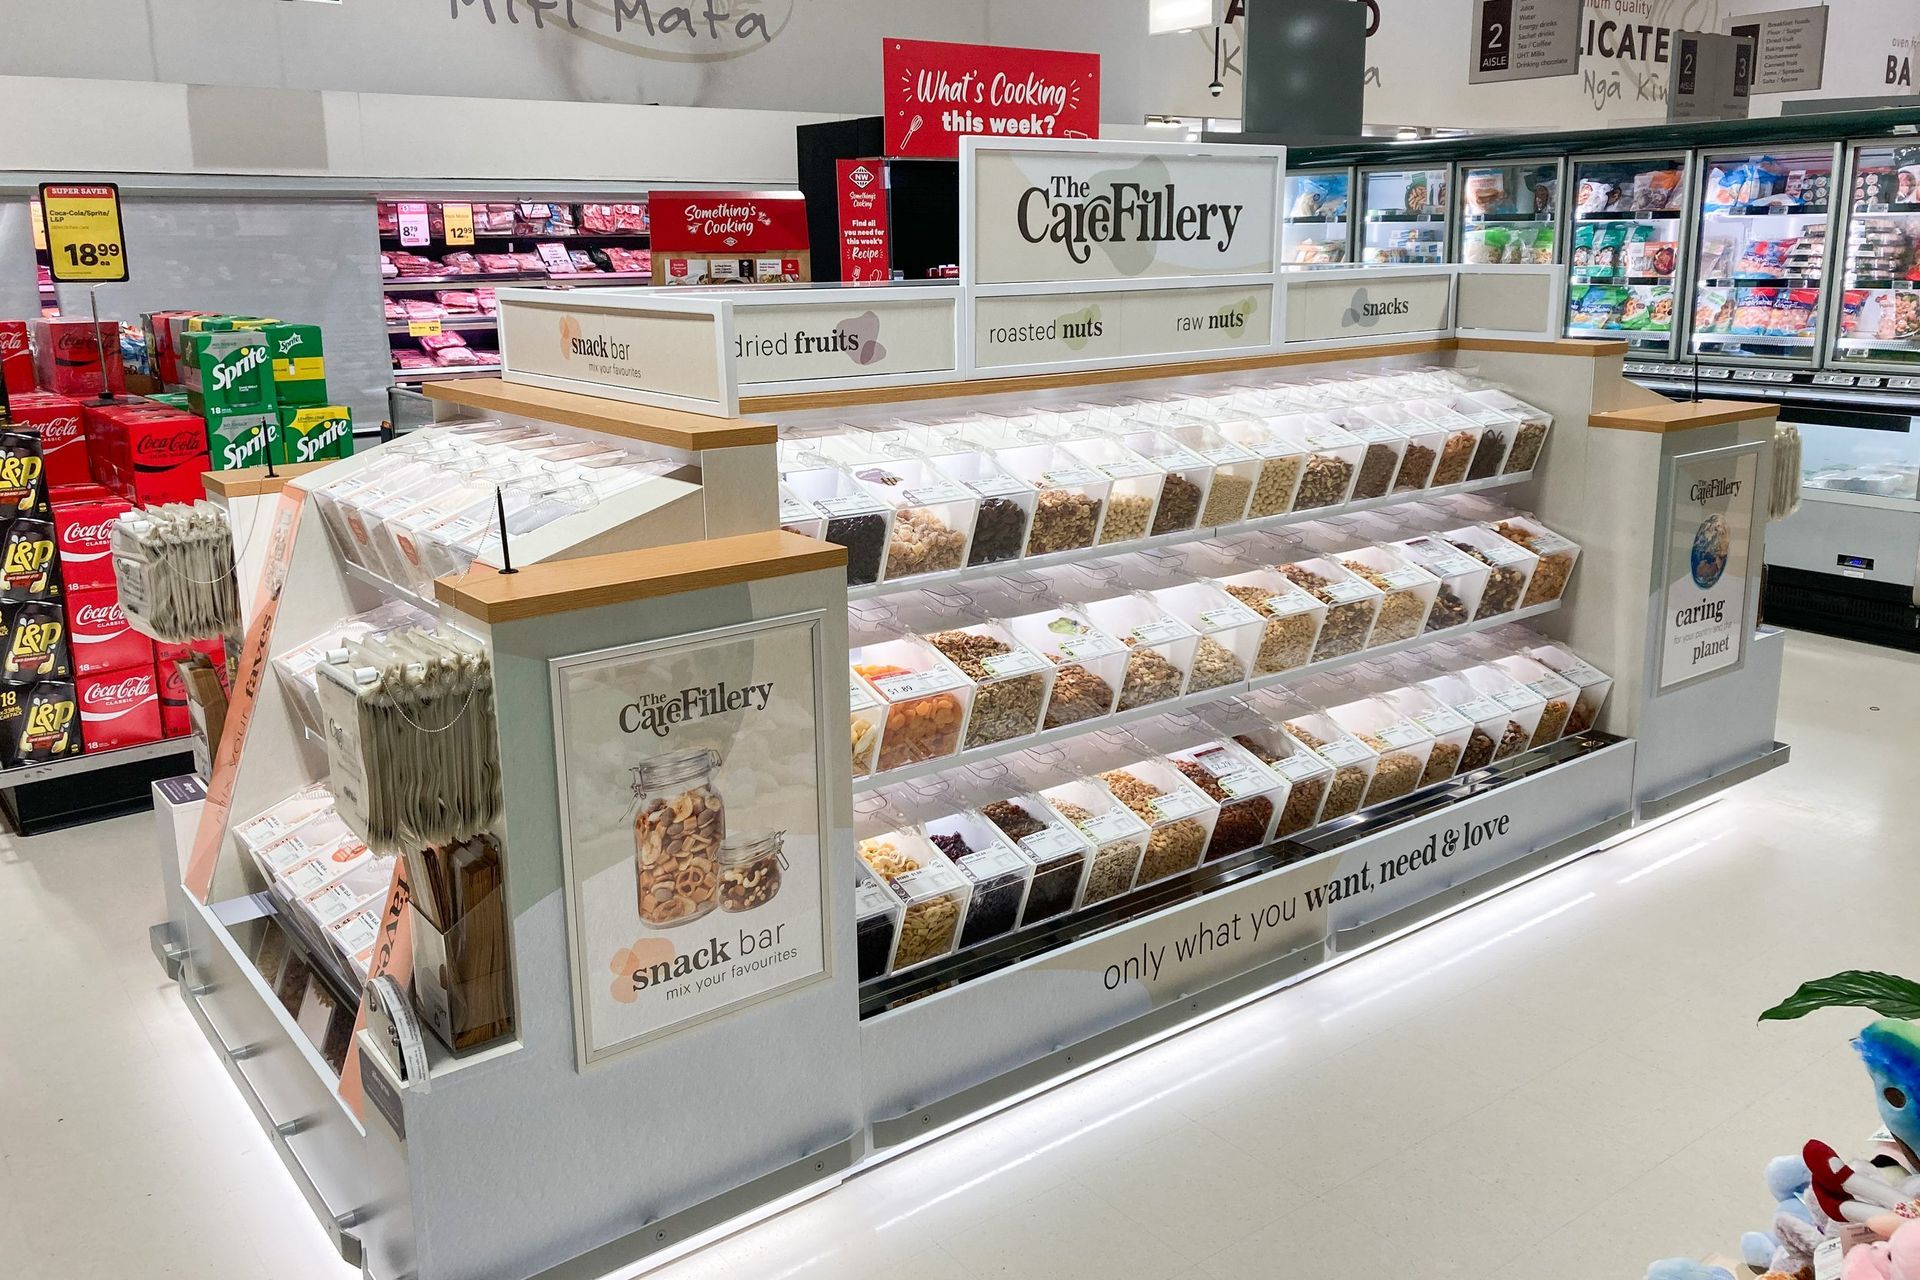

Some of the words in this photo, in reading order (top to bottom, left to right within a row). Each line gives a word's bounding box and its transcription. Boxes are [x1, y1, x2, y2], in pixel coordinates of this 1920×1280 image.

[615, 0, 771, 42] Mata
[1615, 0, 1652, 19] quality
[1489, 23, 1503, 49] 2
[1483, 56, 1506, 67] AISLE
[1684, 54, 1693, 74] 2
[1739, 58, 1746, 78] 3
[1885, 55, 1910, 86] BA
[917, 69, 984, 106] What's
[990, 72, 1067, 116] Cooking
[942, 111, 984, 133] this
[989, 115, 1056, 136] week?
[854, 173, 869, 181] NW
[1051, 176, 1090, 199] The
[684, 202, 757, 221] Something's
[852, 219, 867, 227] Find
[868, 219, 876, 227] all
[1017, 183, 1243, 264] CareFillery
[704, 217, 754, 237] Cooking
[852, 247, 879, 262] Recipe
[1362, 297, 1409, 317] snacks
[989, 320, 1057, 344] roasted
[1062, 316, 1103, 340] nuts
[1177, 314, 1203, 333] raw
[1208, 309, 1244, 330] nuts
[0, 332, 23, 350] ola
[279, 335, 302, 351] Sprite
[571, 334, 609, 358] snack
[610, 339, 630, 361] bar
[736, 332, 788, 358] dried
[794, 328, 859, 354] fruits
[212, 346, 269, 391] Sprite
[588, 362, 599, 373] mix
[600, 365, 611, 375] your
[612, 363, 642, 379] favourites
[211, 407, 221, 415] 18
[223, 425, 279, 471] Sprite
[297, 420, 348, 463] Sprite
[1690, 477, 1742, 506] CareFillery
[4, 540, 55, 574] L&P
[68, 583, 79, 591] 18
[1675, 597, 1726, 628] caring
[12, 622, 62, 656] L&P
[1692, 633, 1730, 665] planet
[79, 664, 90, 672] 18
[0, 691, 16, 707] 18
[105, 697, 134, 706] CLASSIC
[619, 682, 774, 738] CareFillery
[640, 691, 667, 707] The
[26, 699, 75, 736] L&P
[1103, 942, 1166, 990] only
[1175, 913, 1241, 963] what
[1250, 897, 1297, 936] you
[1303, 862, 1375, 912] want,
[1379, 834, 1438, 884] need
[1441, 829, 1461, 857] &
[1462, 813, 1511, 850] love
[632, 936, 732, 992] snack
[739, 920, 786, 957] bar
[666, 983, 692, 1001] mix
[695, 969, 726, 994] your
[731, 946, 798, 978] favourites
